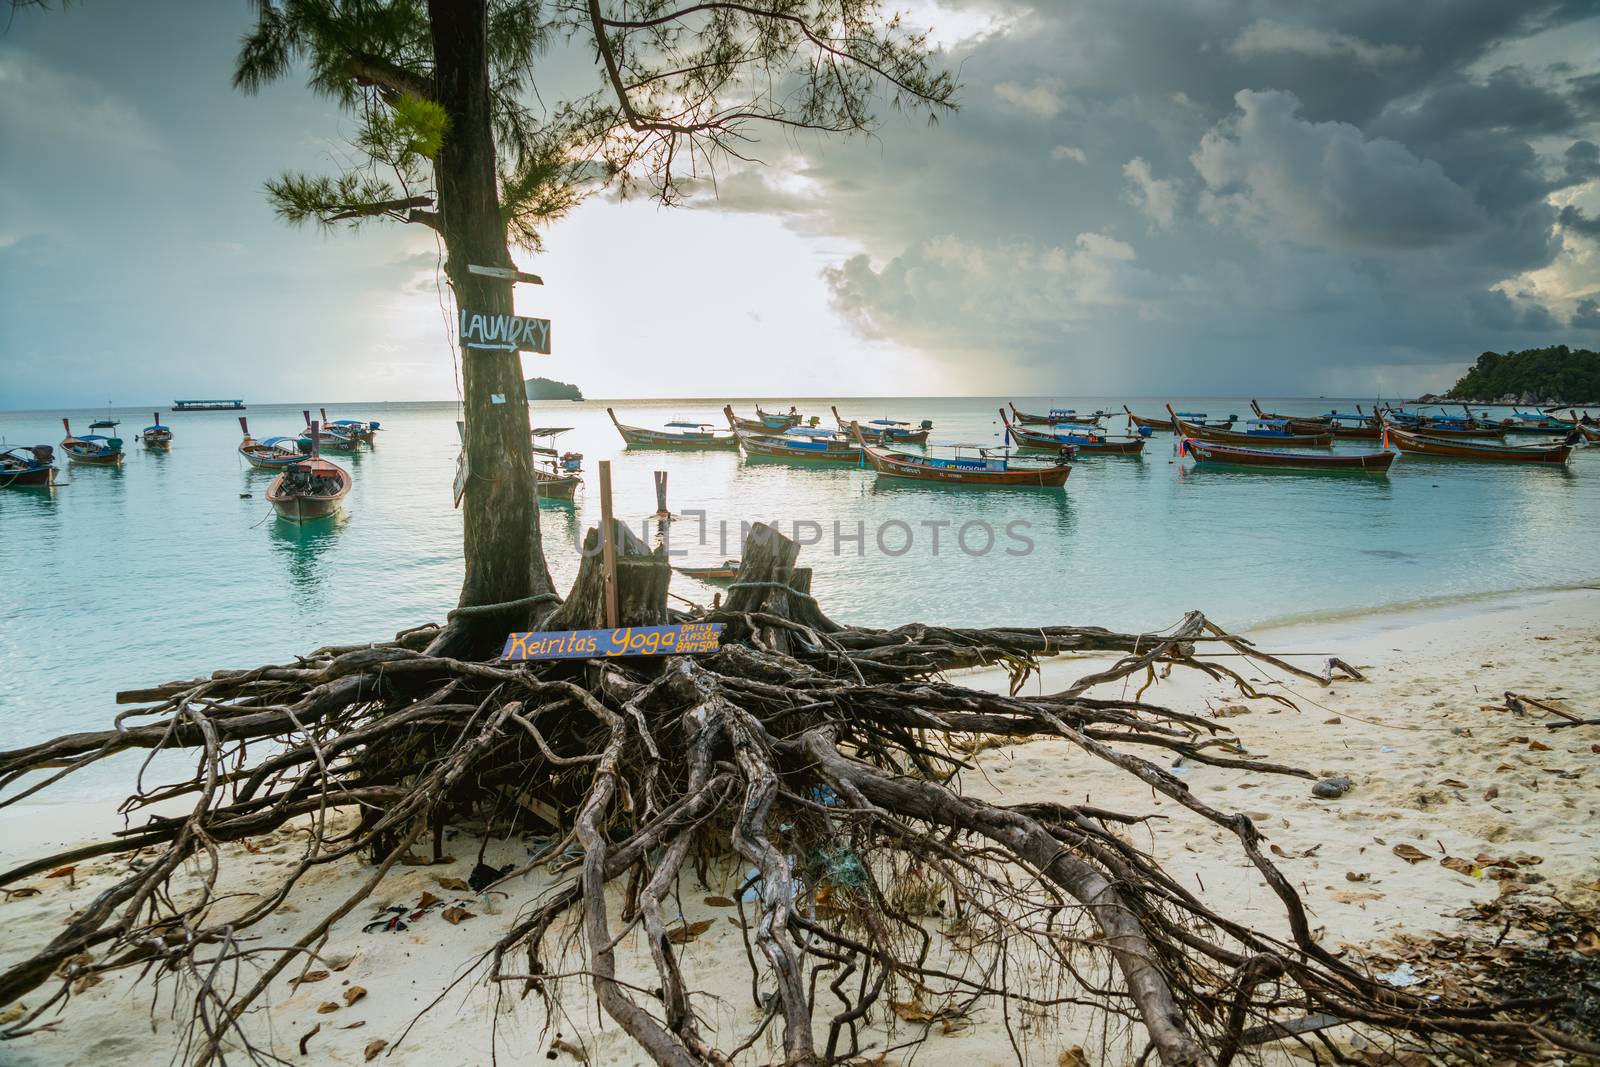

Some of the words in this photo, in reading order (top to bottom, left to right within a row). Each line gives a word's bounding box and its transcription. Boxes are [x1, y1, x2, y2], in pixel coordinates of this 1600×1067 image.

[460, 309, 550, 350] LAUNDRY
[678, 630, 719, 642] CLASSES
[680, 623, 713, 633] DAILY
[606, 627, 675, 656] Yoga
